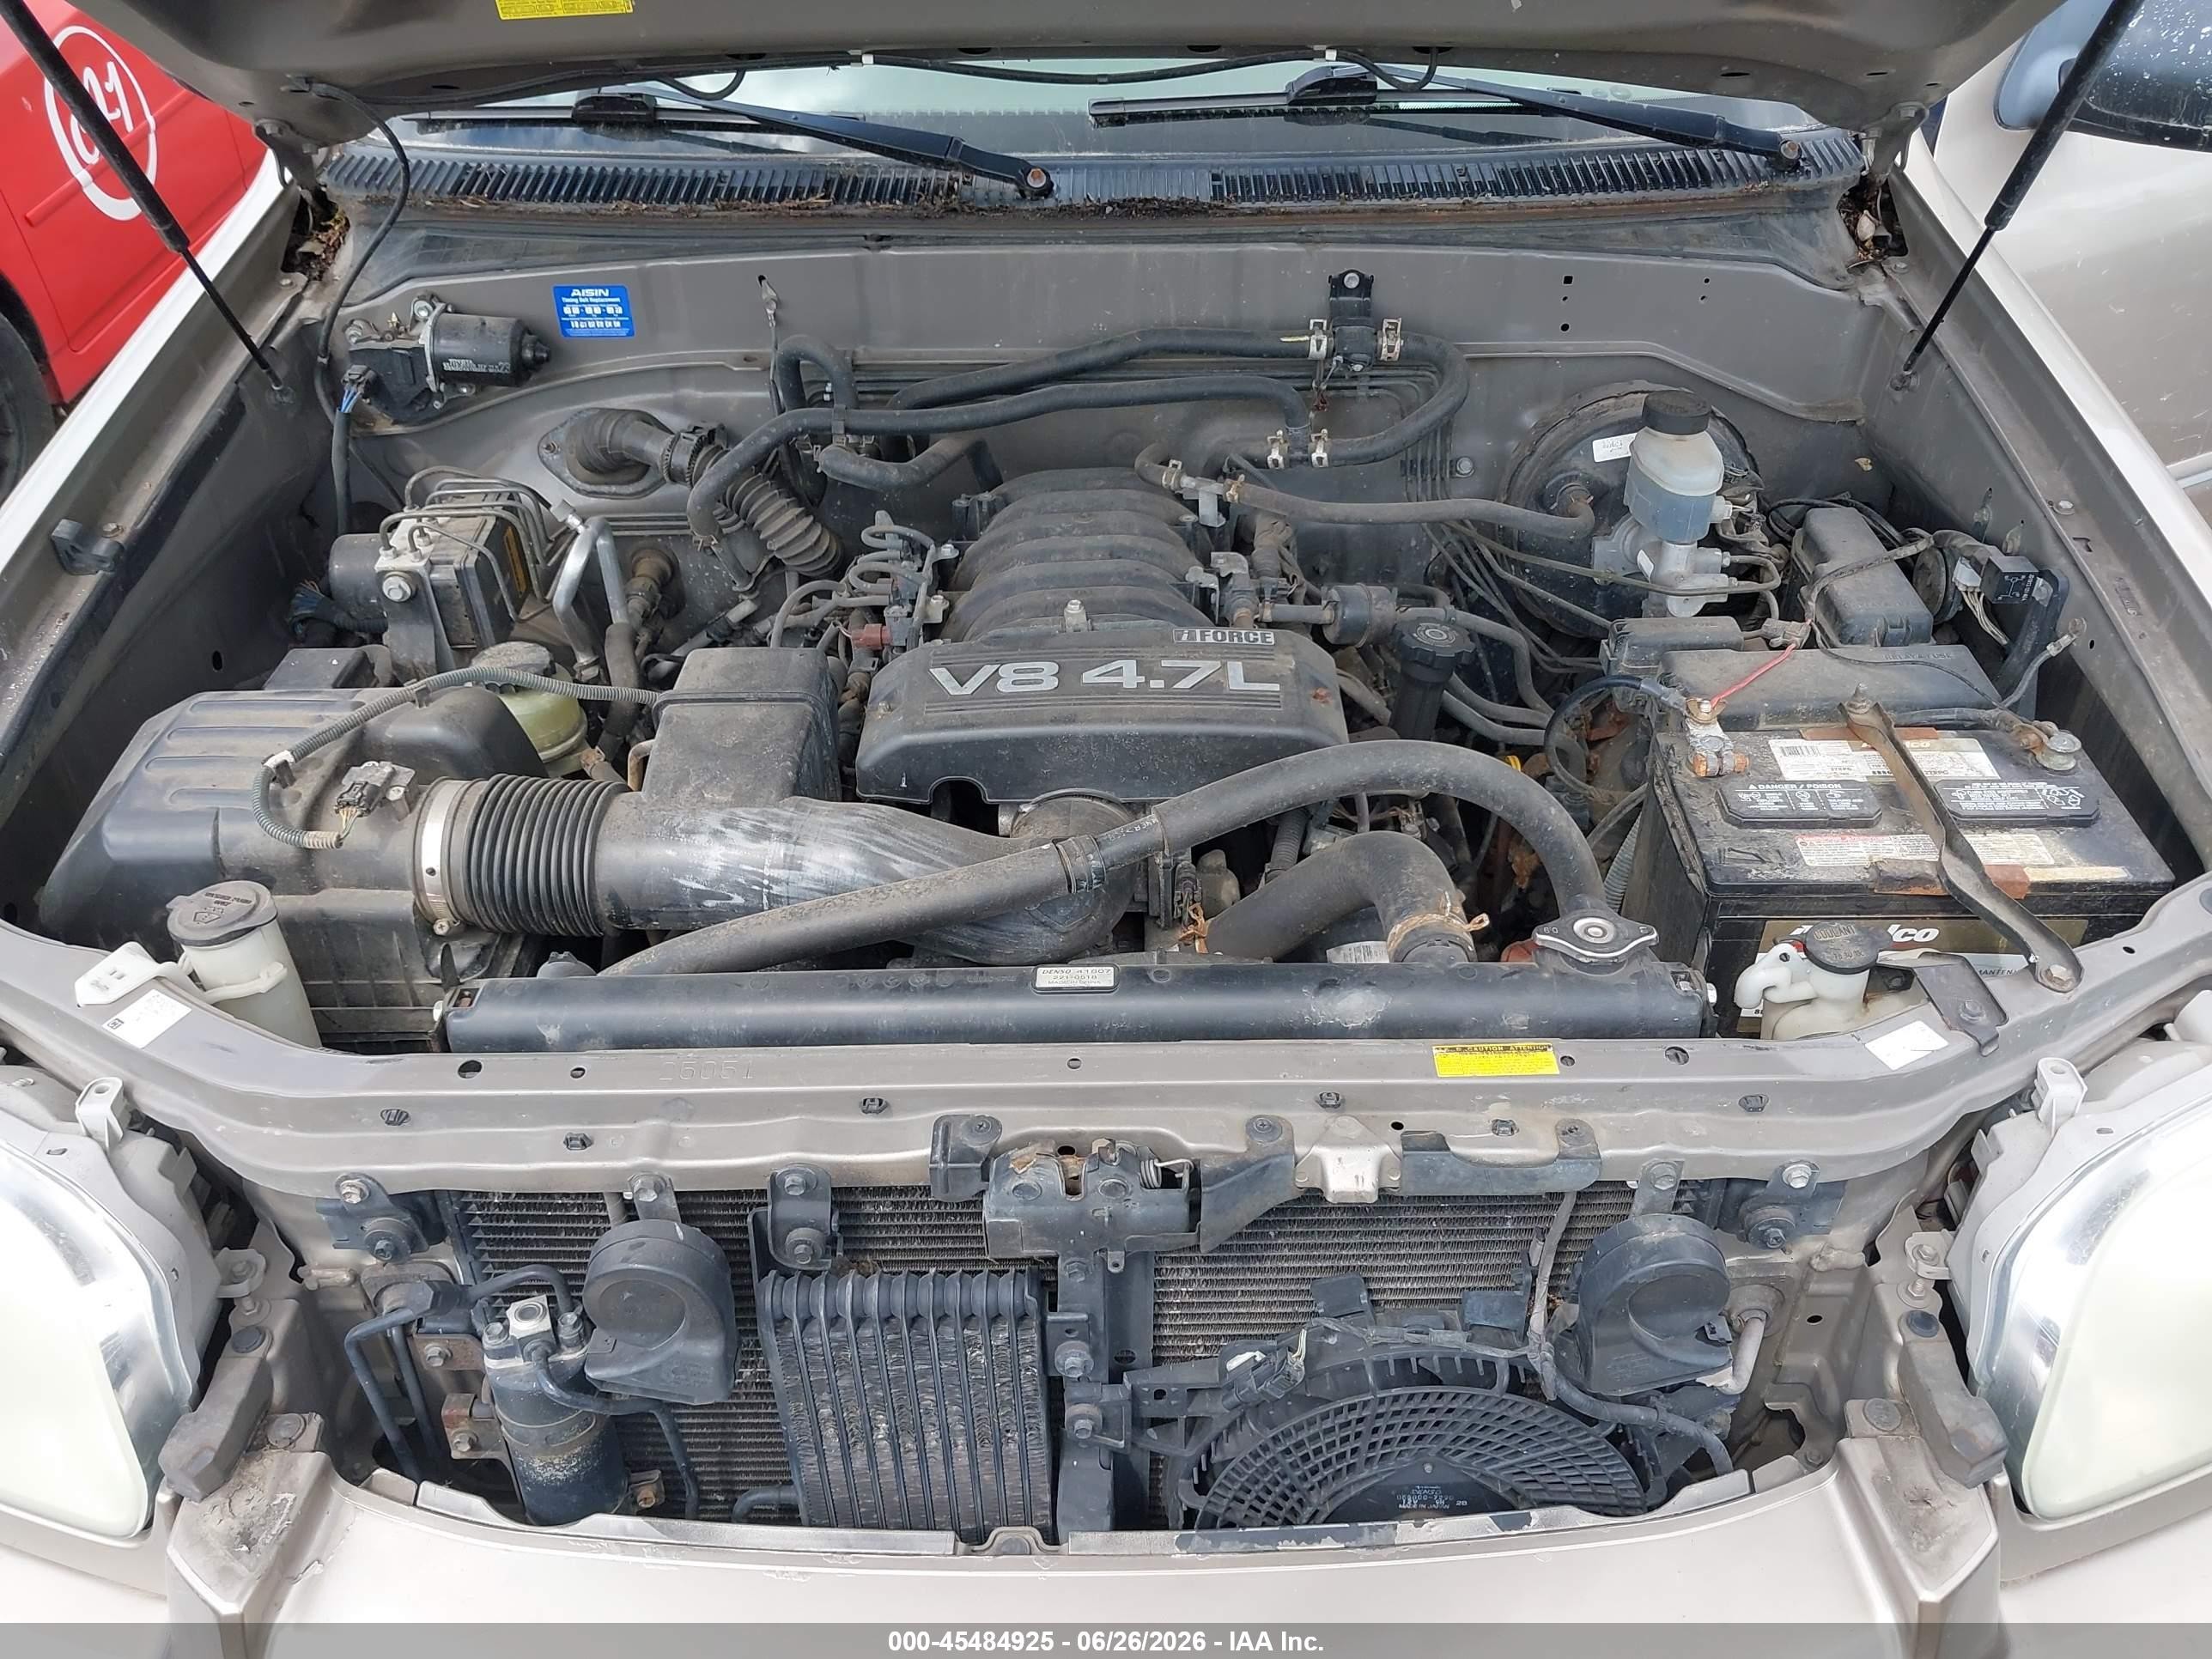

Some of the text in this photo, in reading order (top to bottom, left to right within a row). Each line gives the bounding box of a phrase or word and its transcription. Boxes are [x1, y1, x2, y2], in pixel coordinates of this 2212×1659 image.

[570, 289, 610, 297] AISIN
[928, 659, 1281, 696] V8 4.7L
